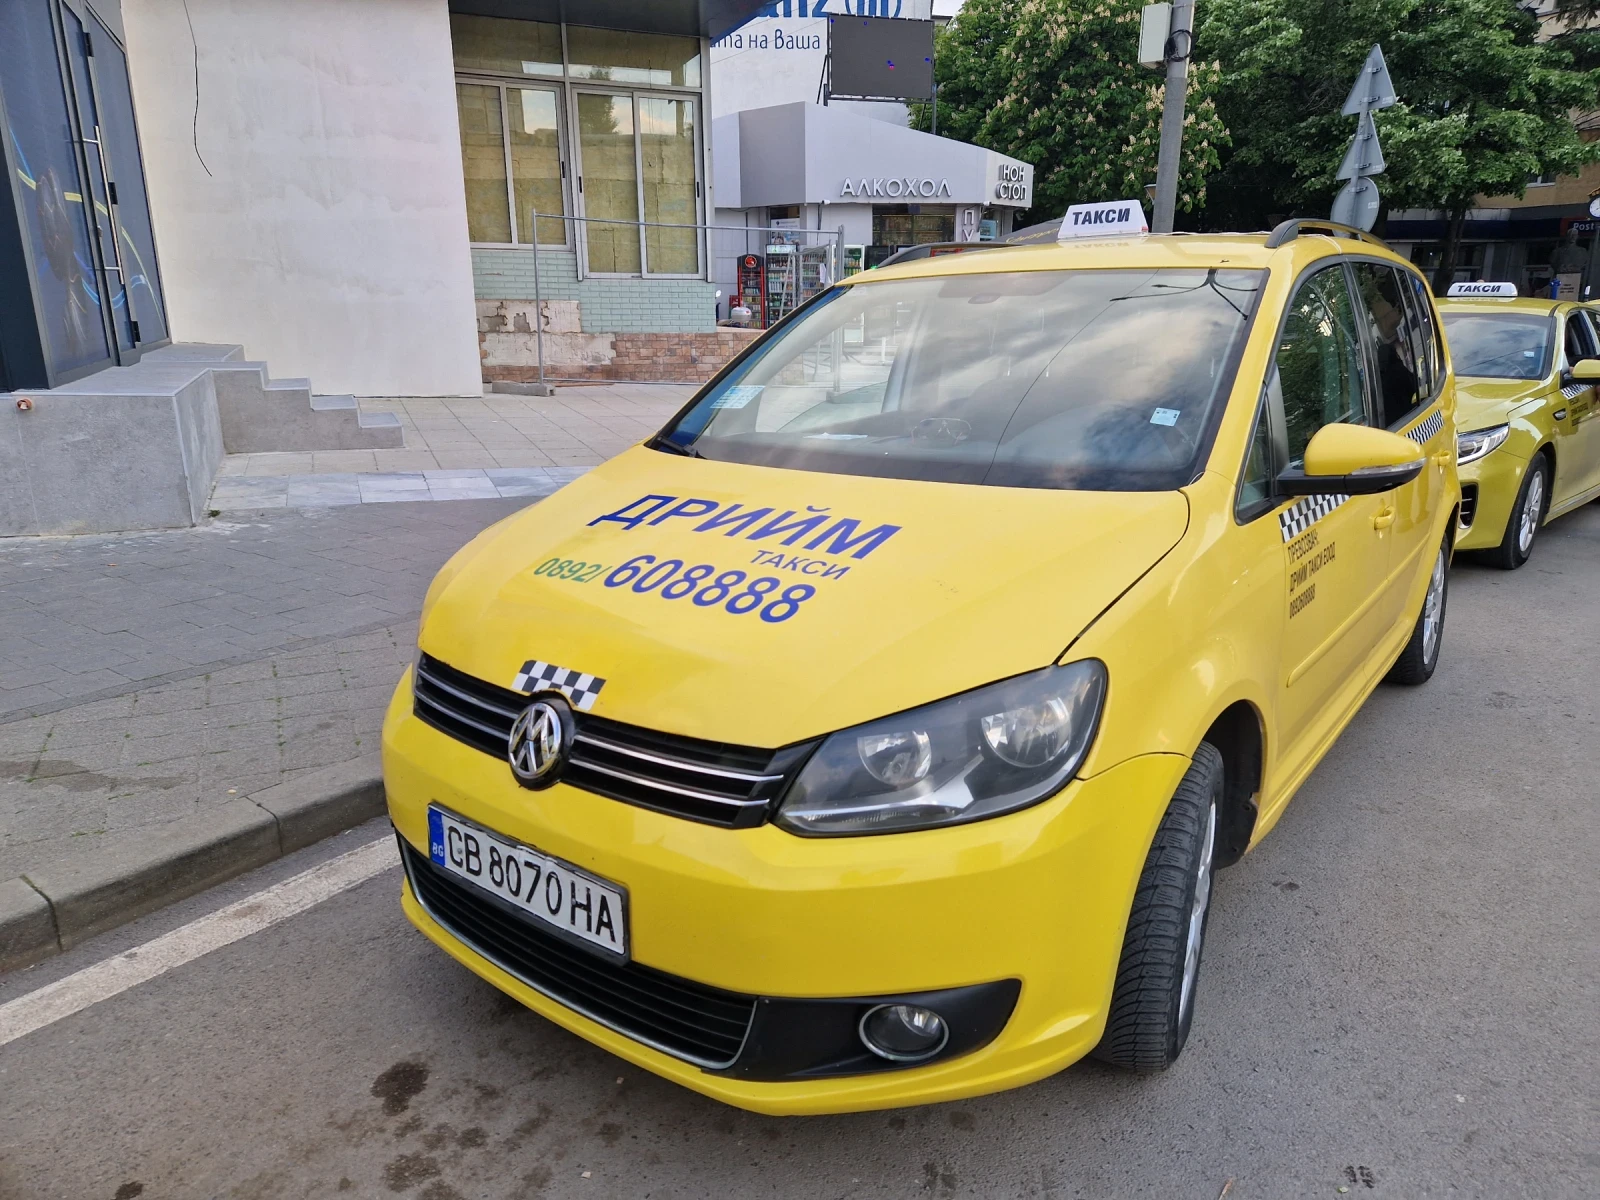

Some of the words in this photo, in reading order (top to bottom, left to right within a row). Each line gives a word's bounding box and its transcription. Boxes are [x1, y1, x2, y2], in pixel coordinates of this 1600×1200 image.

[748, 34, 768, 49] на
[774, 28, 820, 50] Ваша
[1002, 164, 1025, 181] НОН
[840, 177, 952, 197] АЛКОХОЛ
[999, 183, 1027, 200] СТОП
[1072, 207, 1131, 226] ТАКСИ
[1457, 285, 1502, 293] ТАКСИ
[586, 494, 903, 560] ДРИЙМ
[749, 550, 851, 580] ТАКСИ
[432, 844, 444, 858] BG
[489, 845, 562, 916] 8070
